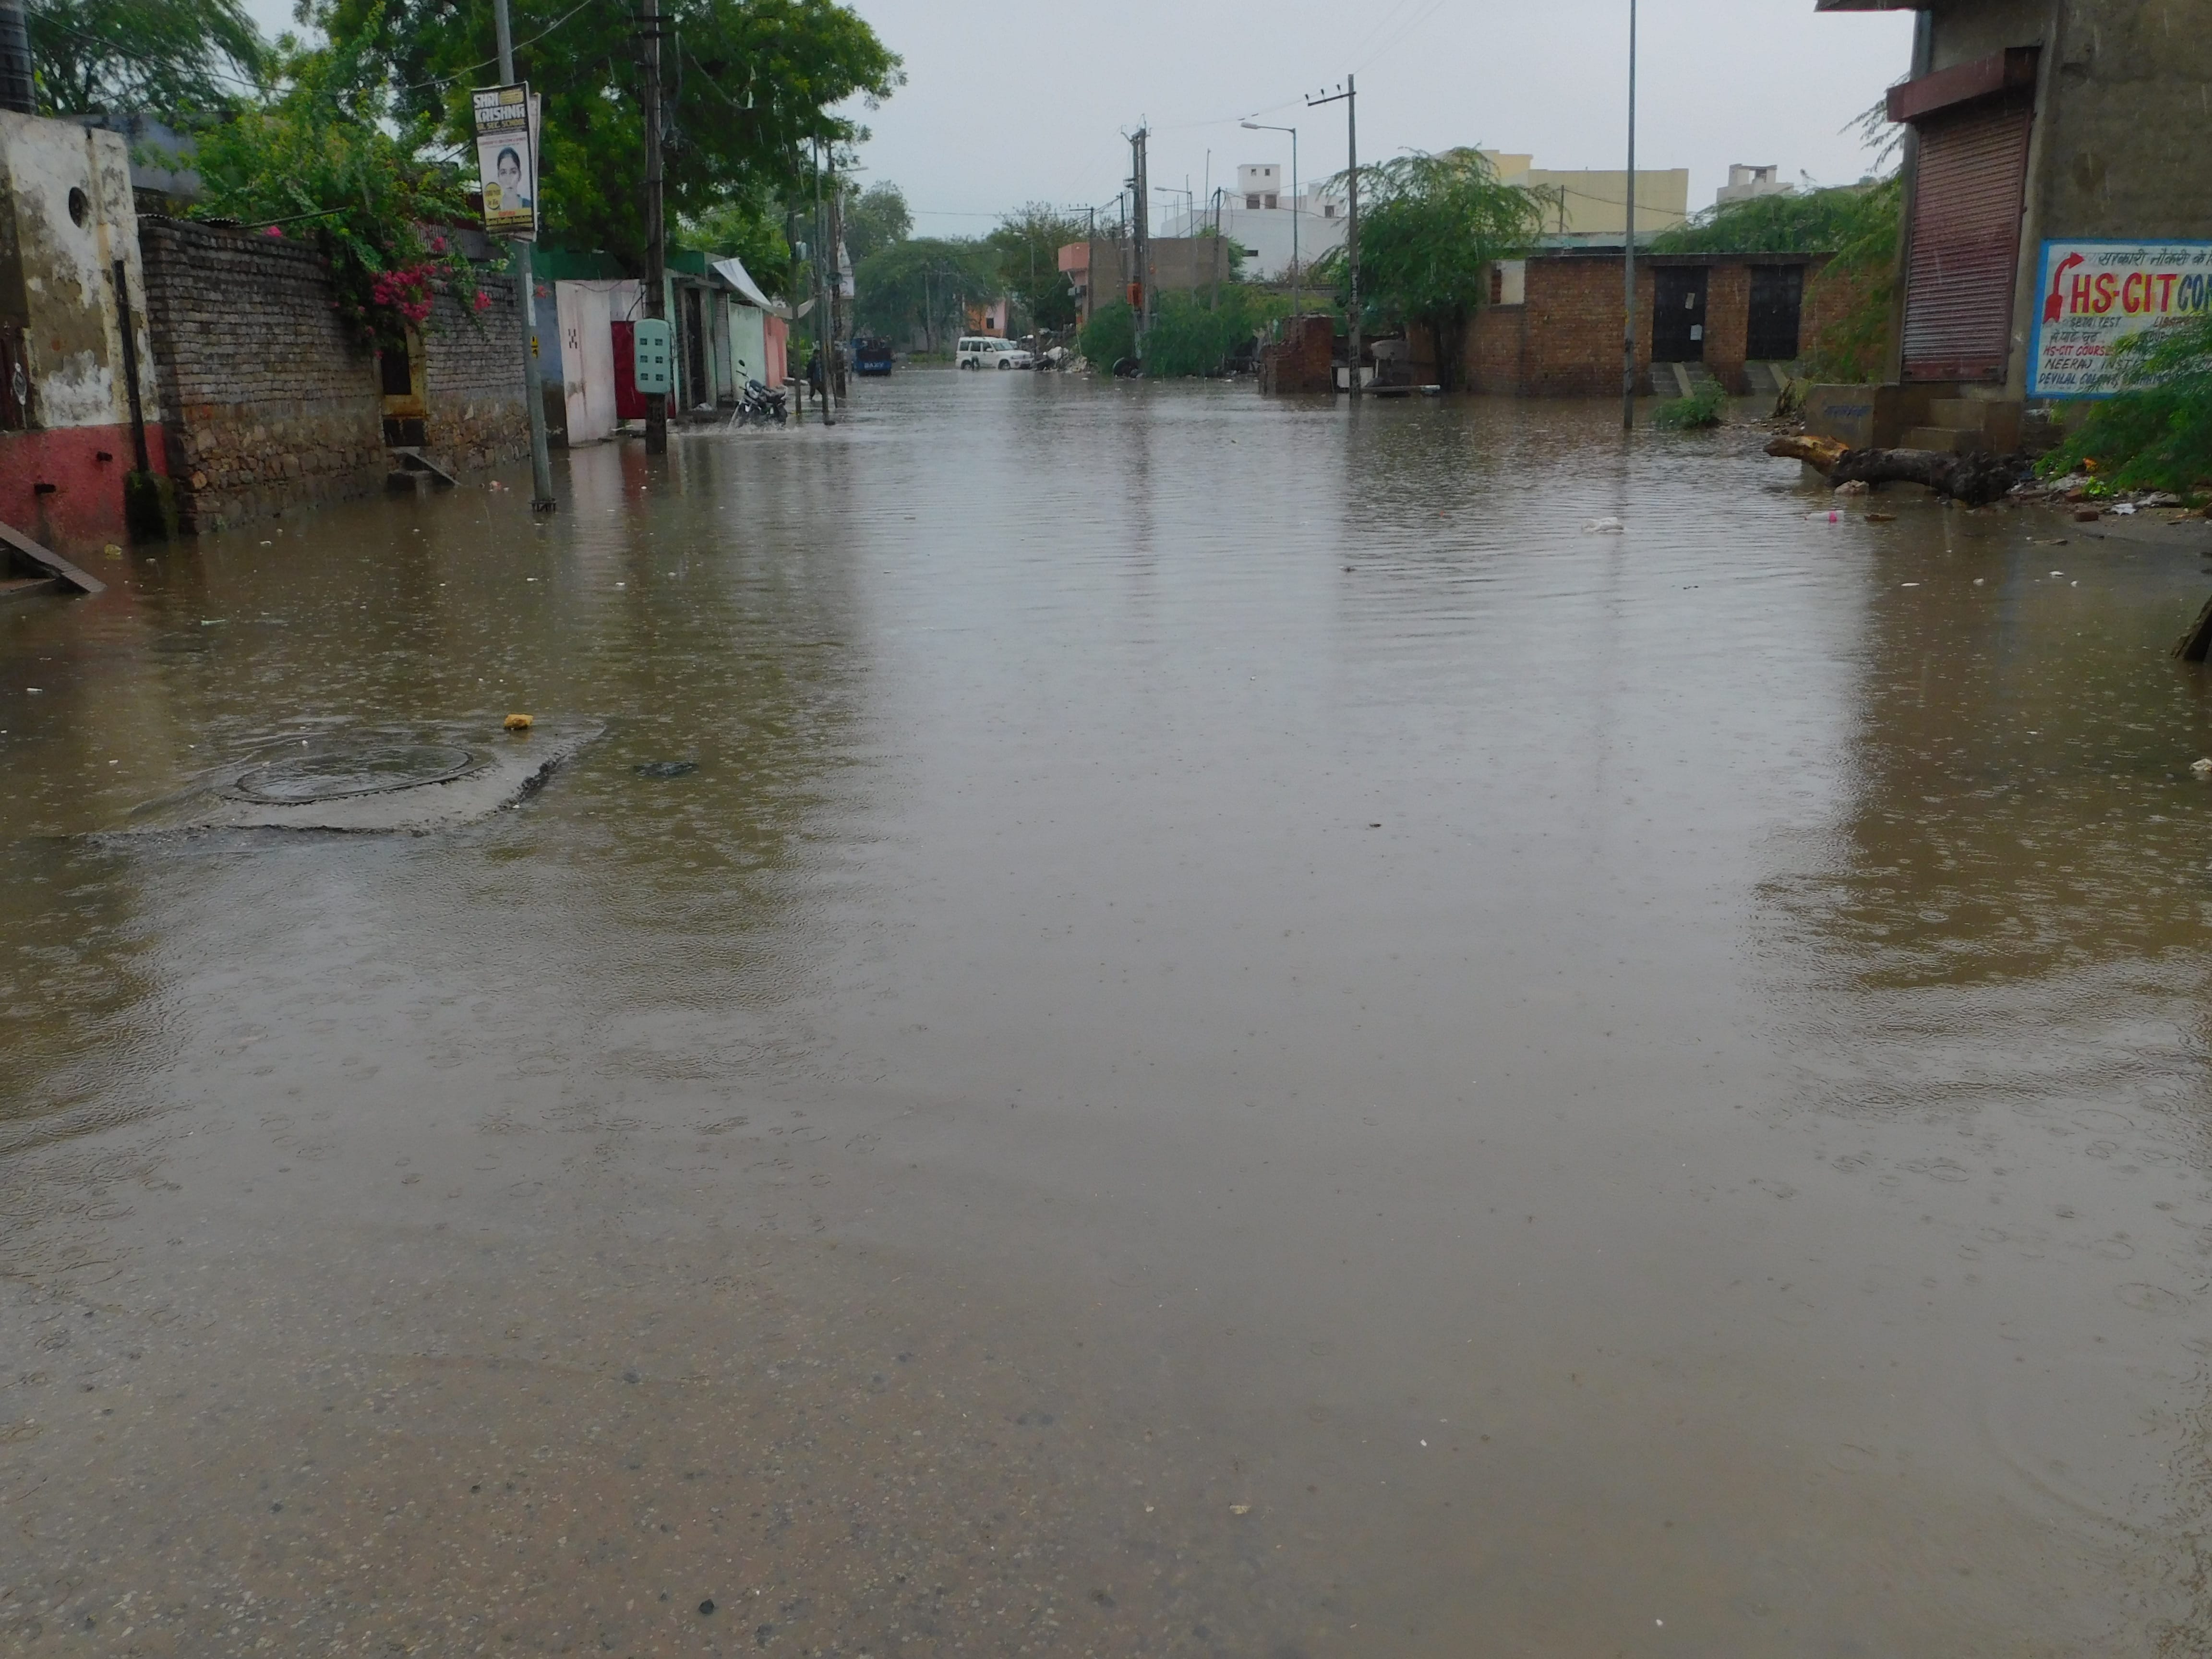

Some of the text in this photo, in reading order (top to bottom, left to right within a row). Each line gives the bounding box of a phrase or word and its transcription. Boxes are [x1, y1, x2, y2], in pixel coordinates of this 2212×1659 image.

[473, 93, 499, 108] SHRI
[475, 103, 525, 123] KRISHNA
[2070, 272, 2177, 313] HS-CIT
[2044, 358, 2092, 370] NEERAJ
